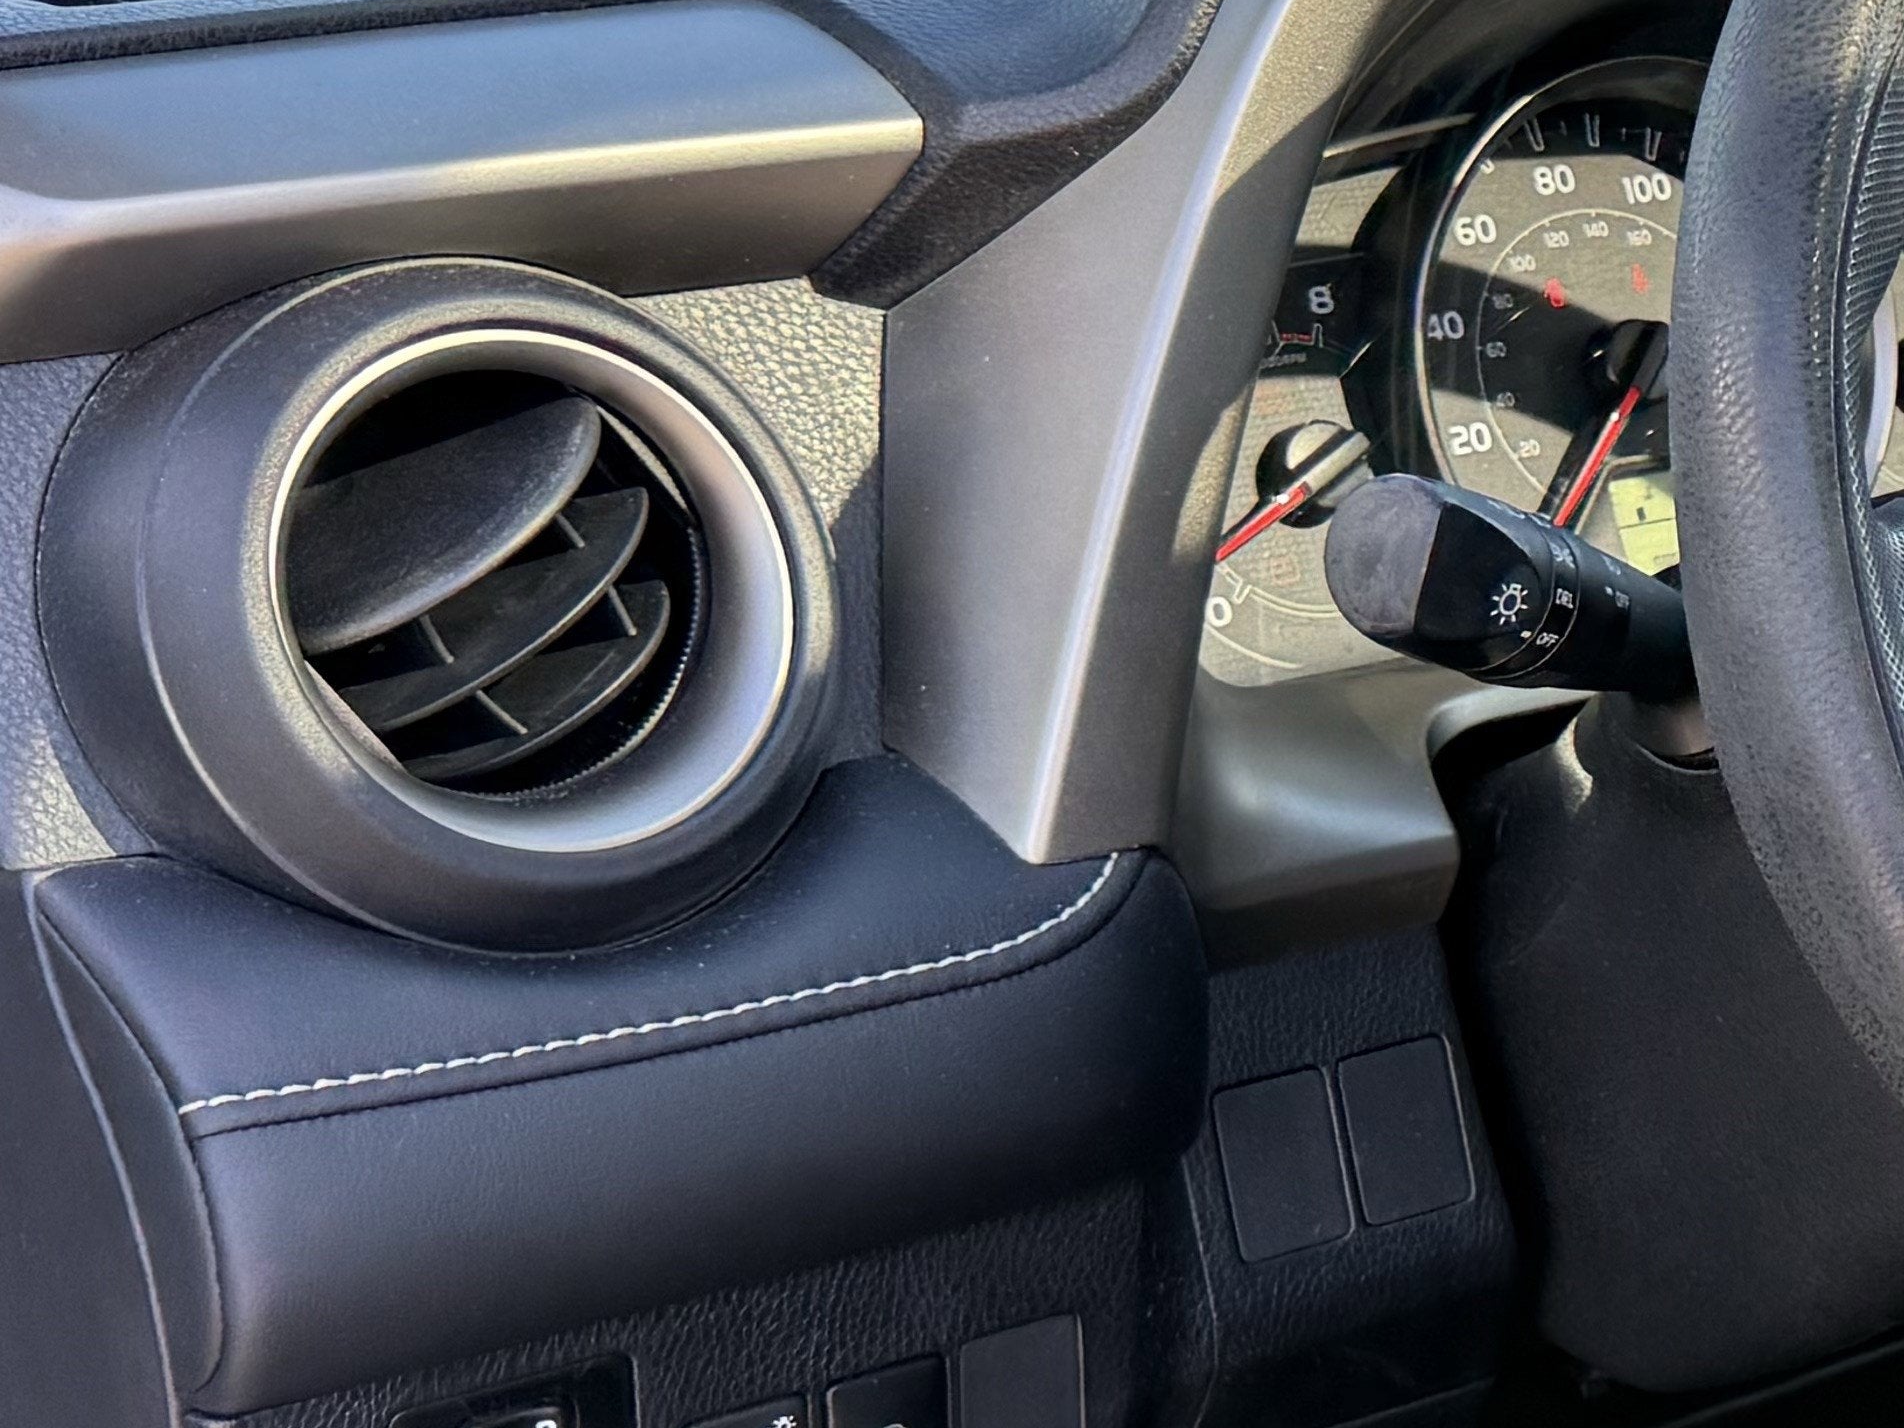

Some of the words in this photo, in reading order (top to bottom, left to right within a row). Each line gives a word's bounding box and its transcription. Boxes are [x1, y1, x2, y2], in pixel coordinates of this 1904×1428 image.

[1533, 164, 1576, 196] 80
[1621, 172, 1672, 205] 100
[1453, 214, 1497, 246] 60
[1543, 230, 1570, 248] 120
[1308, 284, 1335, 314] 8
[1427, 310, 1465, 341] 40
[1449, 422, 1493, 456] 20
[1518, 438, 1541, 458] 20
[1536, 631, 1559, 647] OFF
